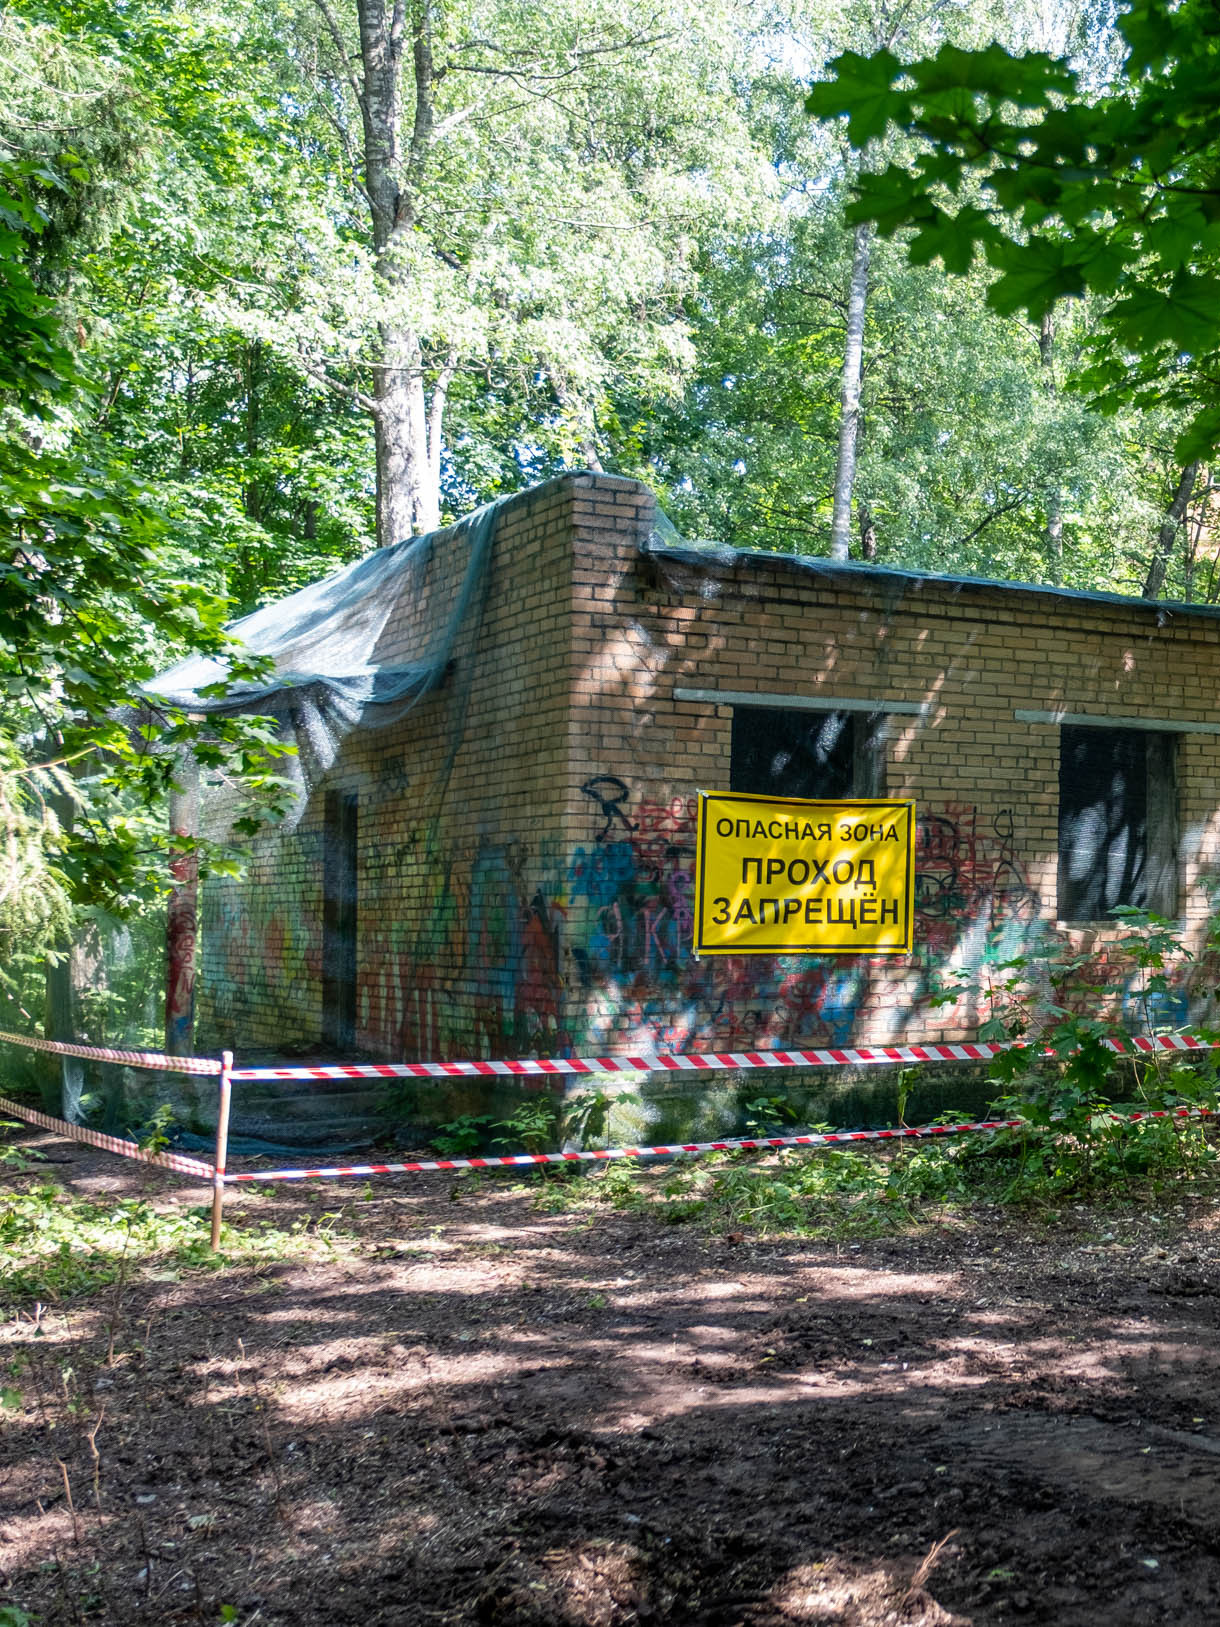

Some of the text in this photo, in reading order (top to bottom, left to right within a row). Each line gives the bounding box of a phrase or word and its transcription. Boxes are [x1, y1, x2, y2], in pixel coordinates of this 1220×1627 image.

[716, 818, 900, 842] ОПАСНАЯ ЗОНА
[742, 857, 877, 891] ПРОХОД
[711, 892, 899, 930] ЗАПРЕЩЁН
